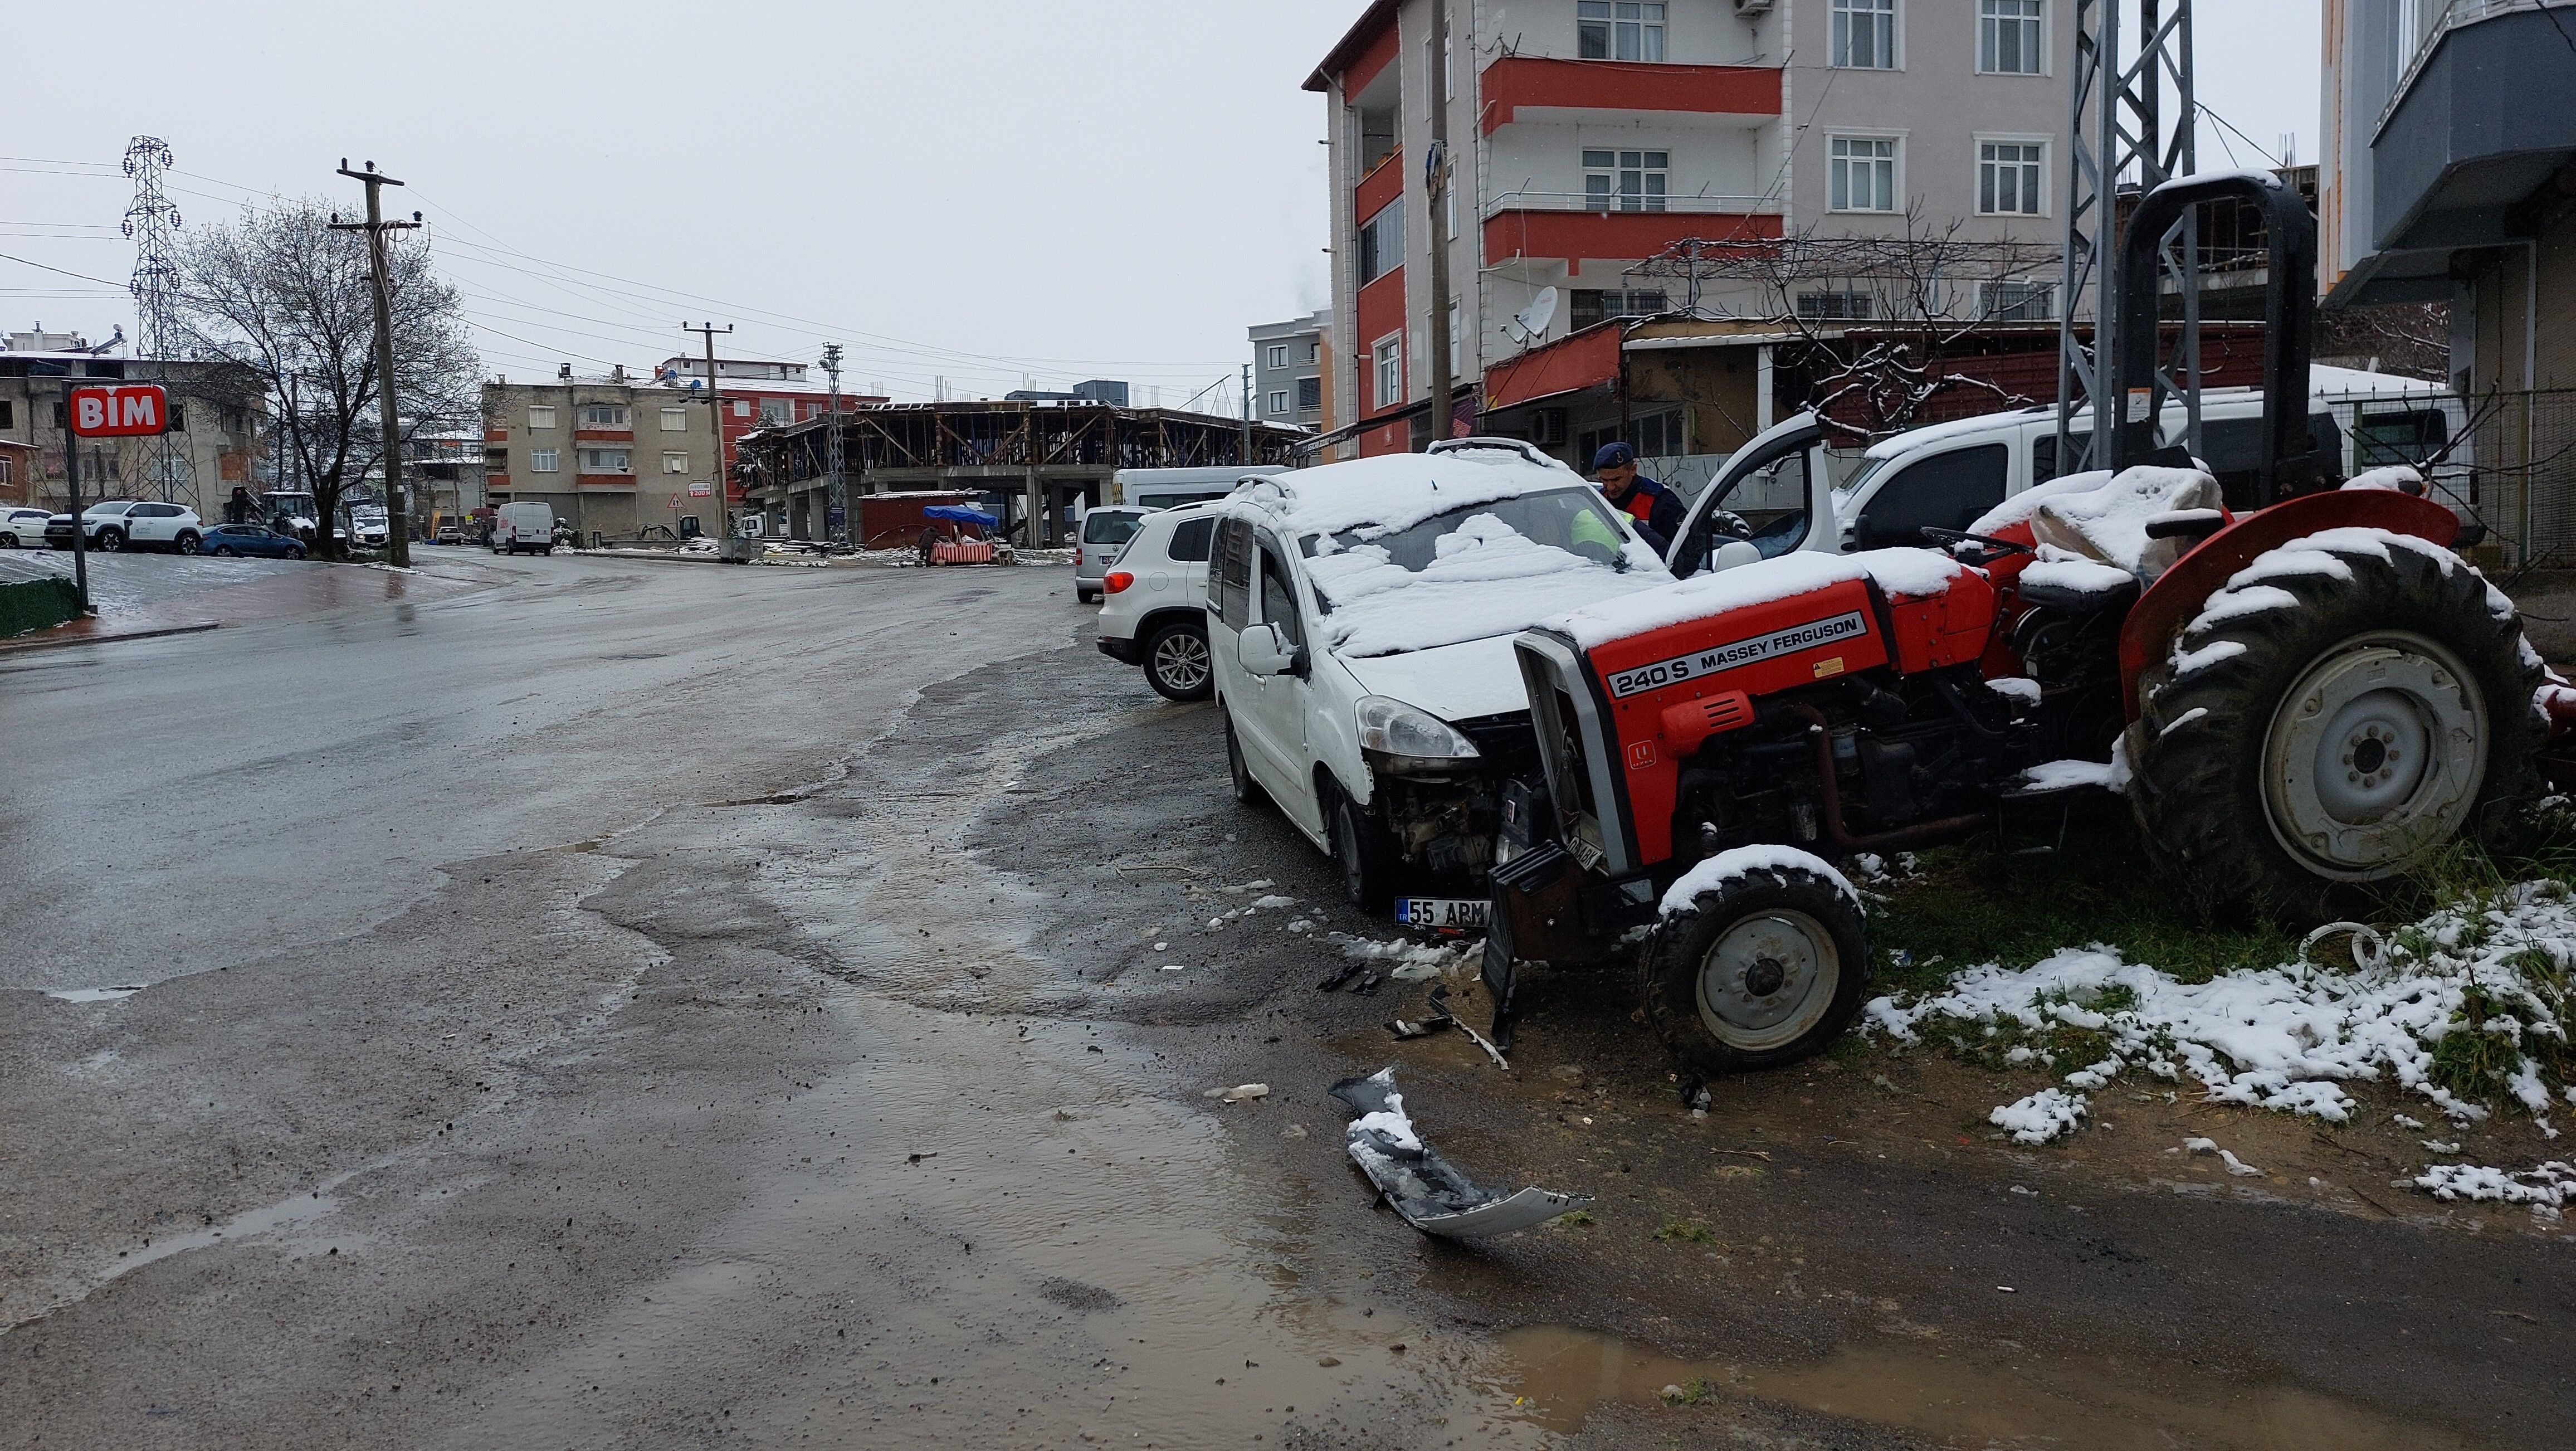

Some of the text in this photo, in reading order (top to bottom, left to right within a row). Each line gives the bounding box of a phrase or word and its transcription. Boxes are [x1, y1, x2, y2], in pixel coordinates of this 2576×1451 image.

[1617, 618, 1857, 694] 240 S MASSEY FERGUSON
[1409, 901, 1434, 924] 55
